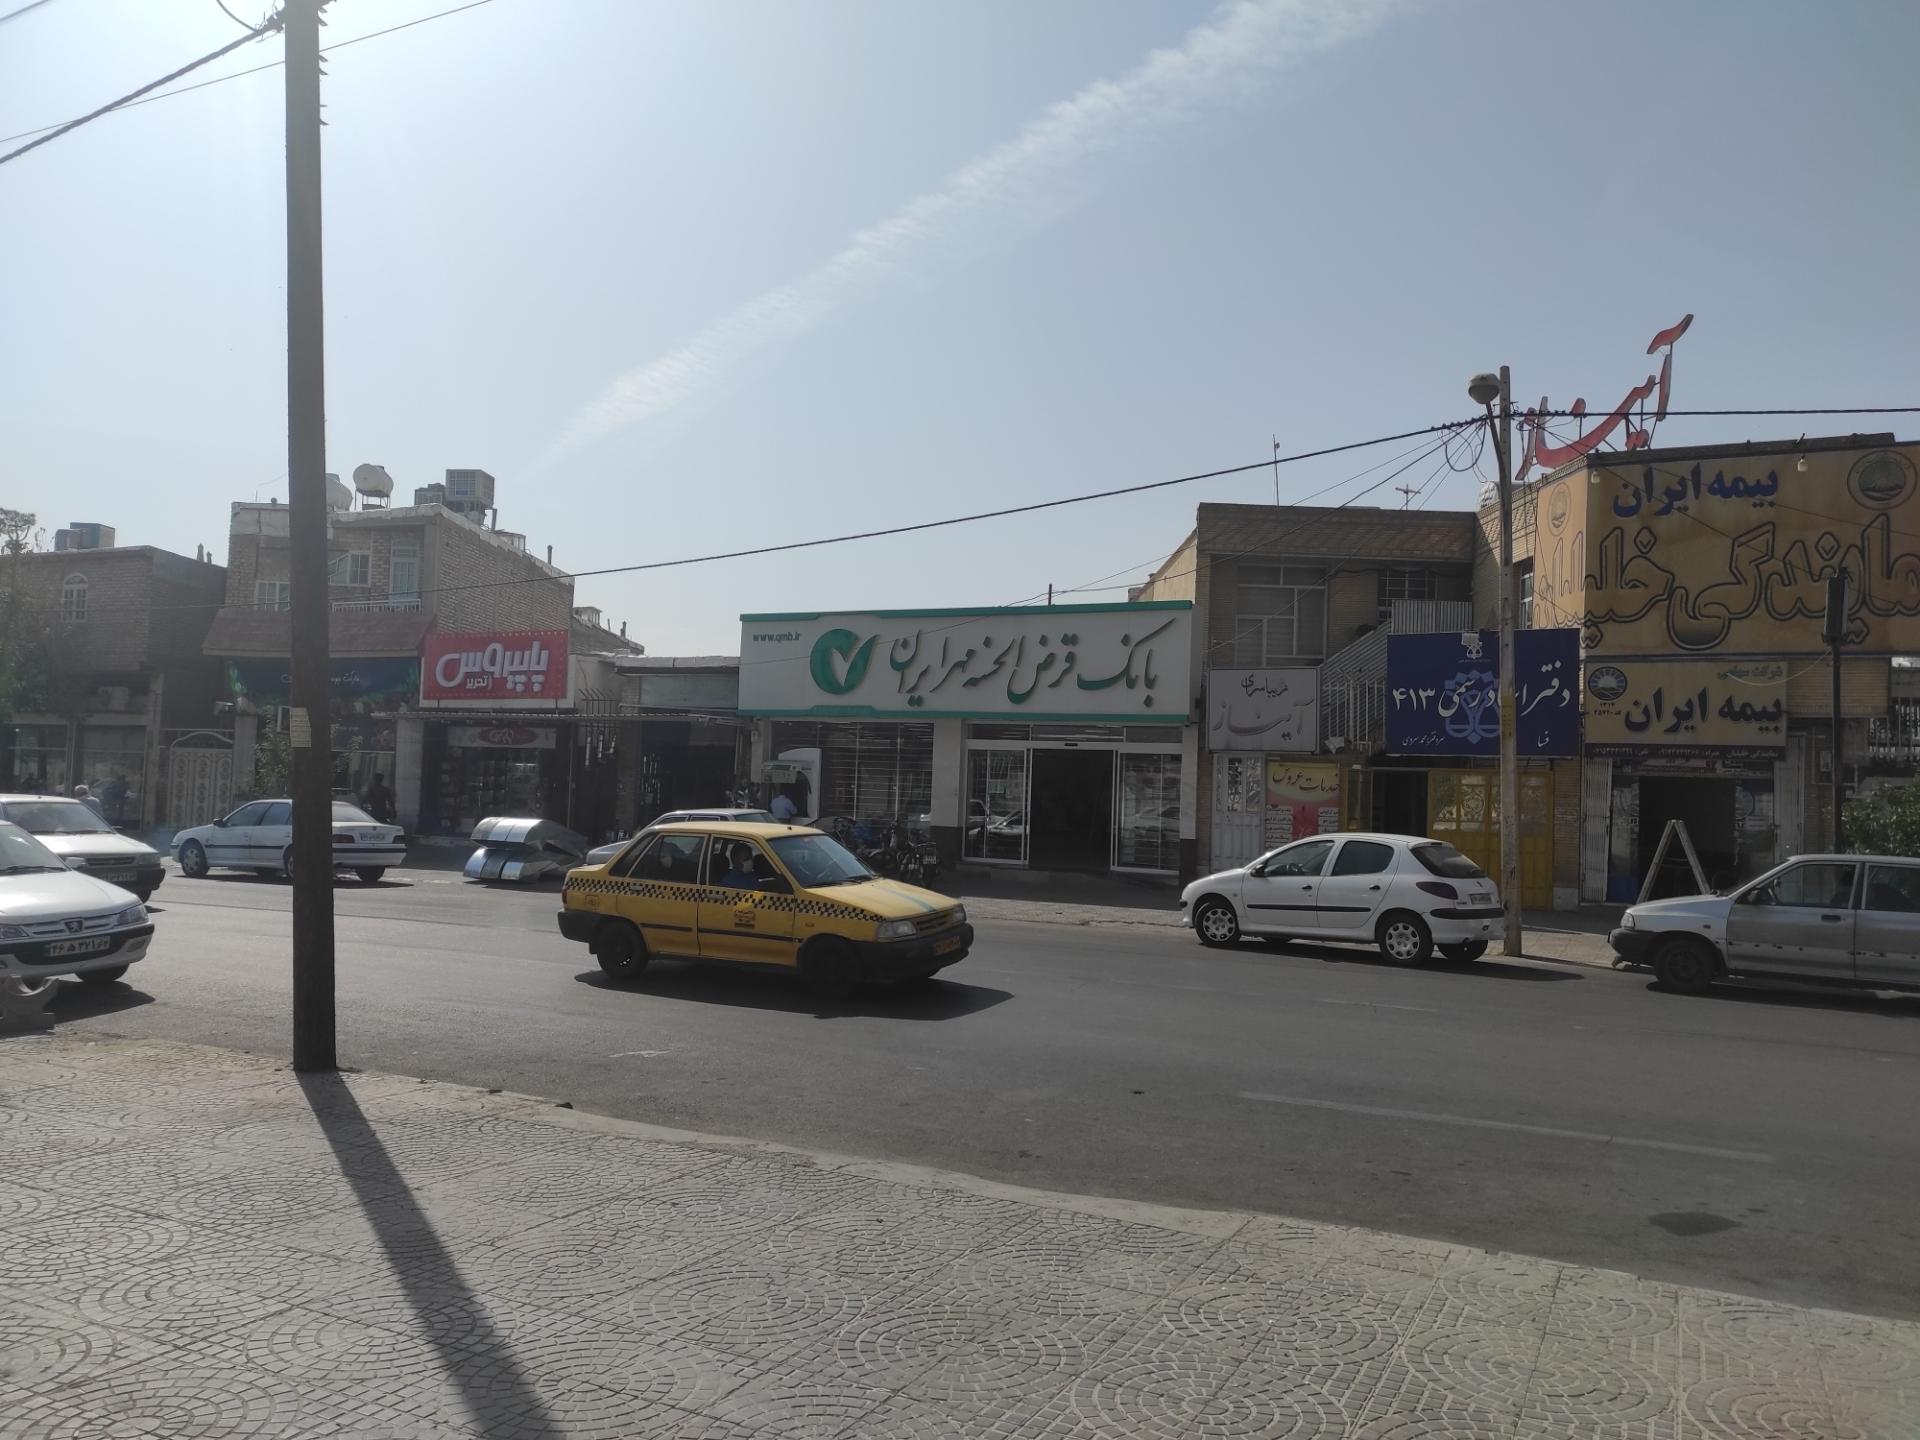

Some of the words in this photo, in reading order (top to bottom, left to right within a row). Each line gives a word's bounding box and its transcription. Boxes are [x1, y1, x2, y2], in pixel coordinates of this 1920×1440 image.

[1613, 462, 1701, 518] ایران
[1707, 470, 1779, 508] بیمه
[752, 631, 801, 643] www.qmb.ir
[889, 629, 950, 708] ایران
[1077, 617, 1177, 708] بانک
[1392, 687, 1436, 711] ۴۱۳
[1520, 660, 1571, 717] دفتر
[1624, 686, 1709, 732] ایران
[1718, 695, 1784, 734] بیمه
